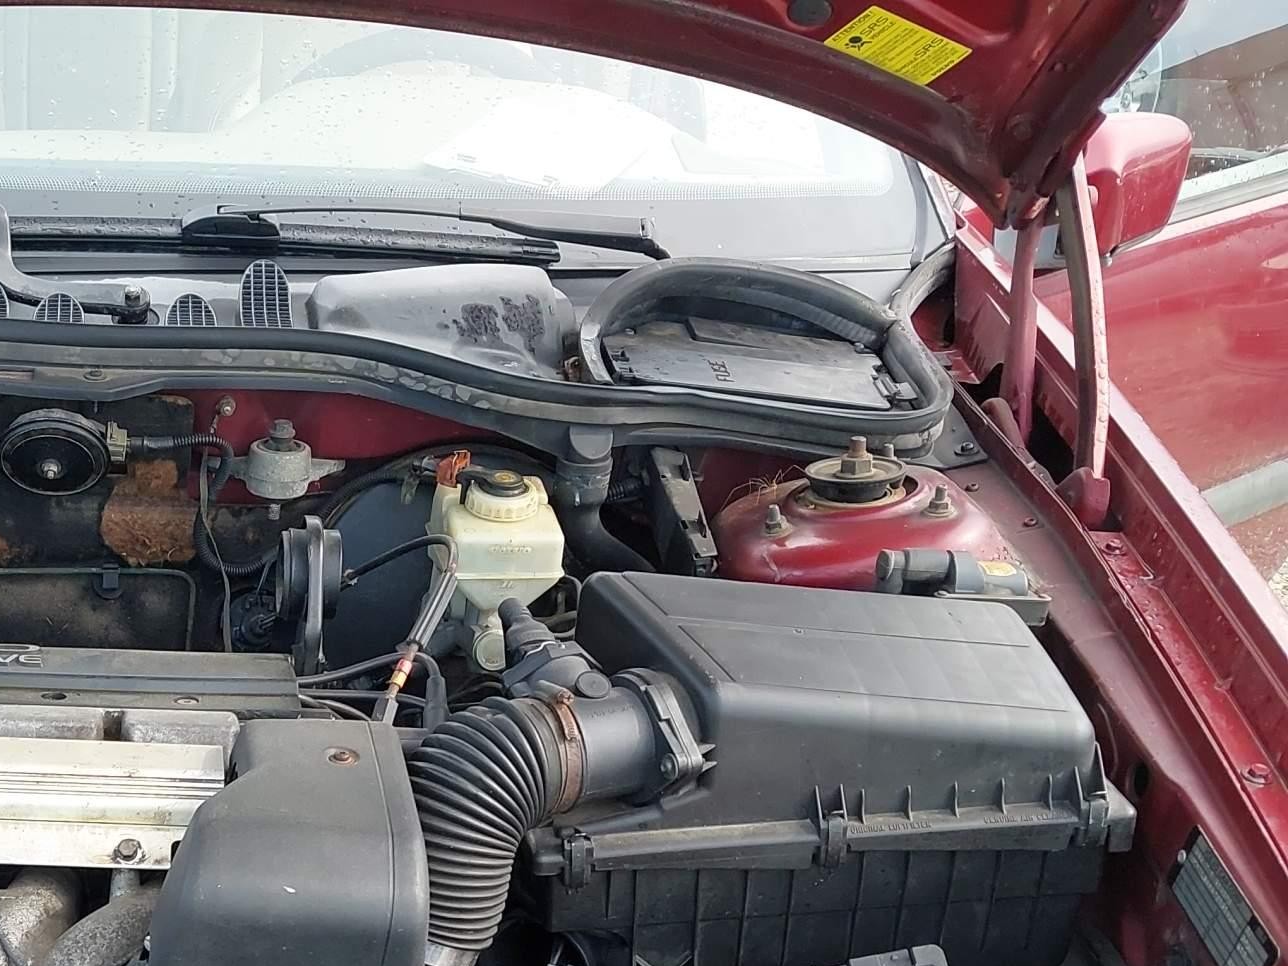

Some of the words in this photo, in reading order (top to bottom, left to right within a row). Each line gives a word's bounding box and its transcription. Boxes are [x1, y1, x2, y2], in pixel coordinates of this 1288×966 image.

[859, 16, 889, 38] SRS
[915, 37, 944, 59] SRS
[707, 360, 736, 382] FUSE
